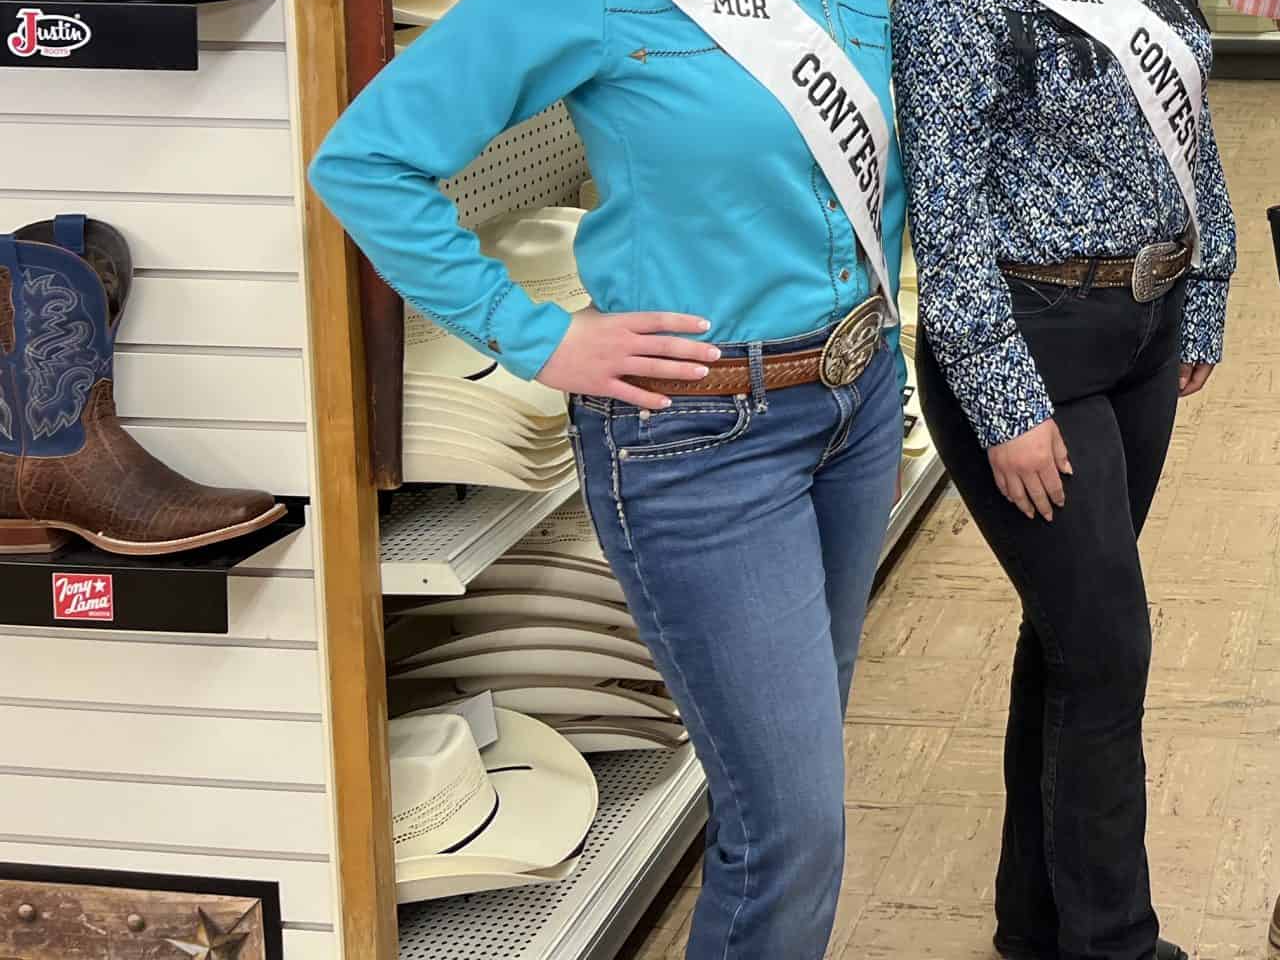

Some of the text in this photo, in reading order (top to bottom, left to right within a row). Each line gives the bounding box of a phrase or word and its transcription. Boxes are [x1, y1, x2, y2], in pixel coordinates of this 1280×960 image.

[9, 9, 83, 55] Justin
[55, 577, 93, 603] Tony
[64, 594, 111, 615] Lama
